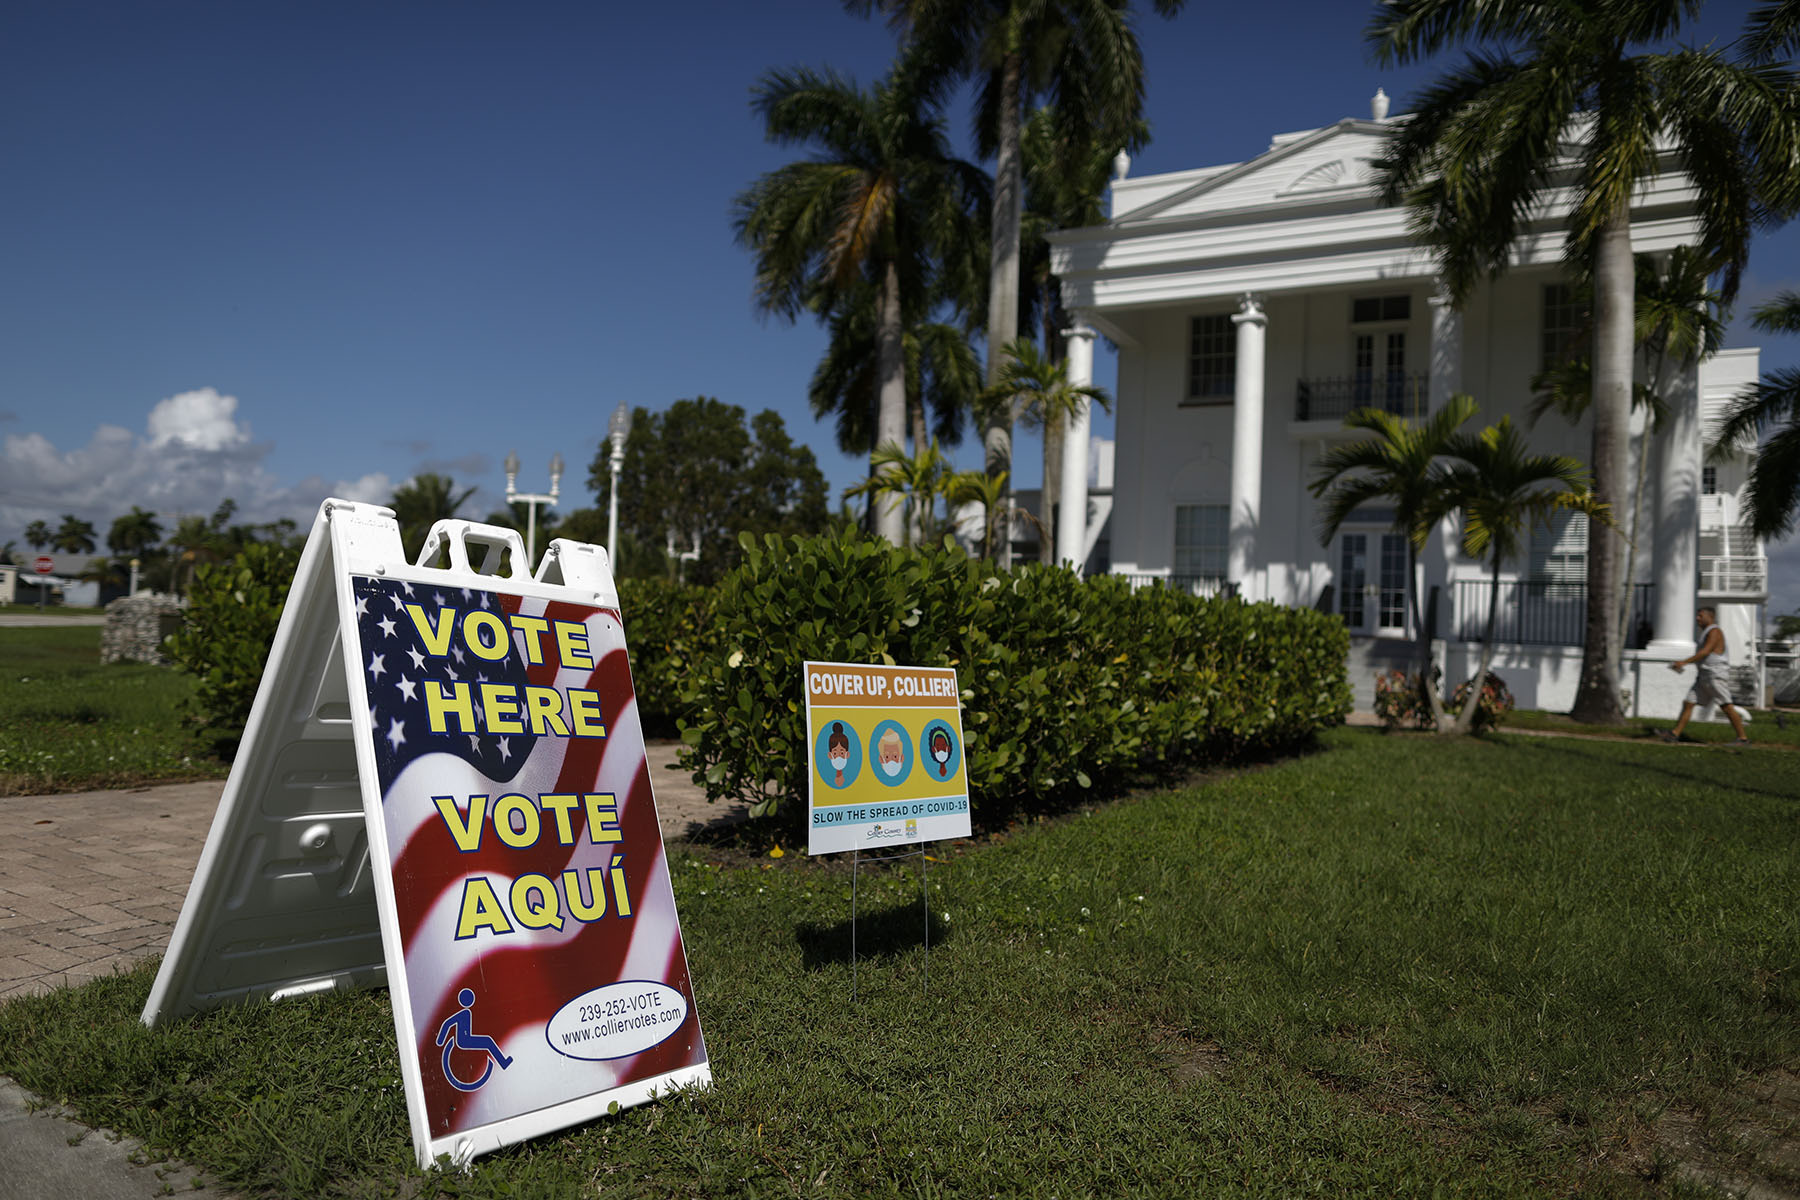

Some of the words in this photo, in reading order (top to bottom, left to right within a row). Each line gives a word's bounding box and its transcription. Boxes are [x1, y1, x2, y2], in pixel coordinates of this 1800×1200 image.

[401, 601, 595, 671] VOTE
[422, 679, 608, 739] HERE
[810, 673, 864, 695] COVER
[866, 675, 892, 699] UP,
[893, 676, 956, 697] COLLIER!
[431, 792, 624, 854] VOTE
[813, 811, 843, 824] SLOW
[847, 809, 866, 821] THE
[869, 805, 909, 819] SPREAD
[912, 803, 924, 815] OF
[927, 800, 968, 813] COVID-19
[454, 853, 633, 941] AQUÍ
[562, 1007, 681, 1045] www.colliervotes.com
[579, 991, 662, 1022] 239-252-VOTE
